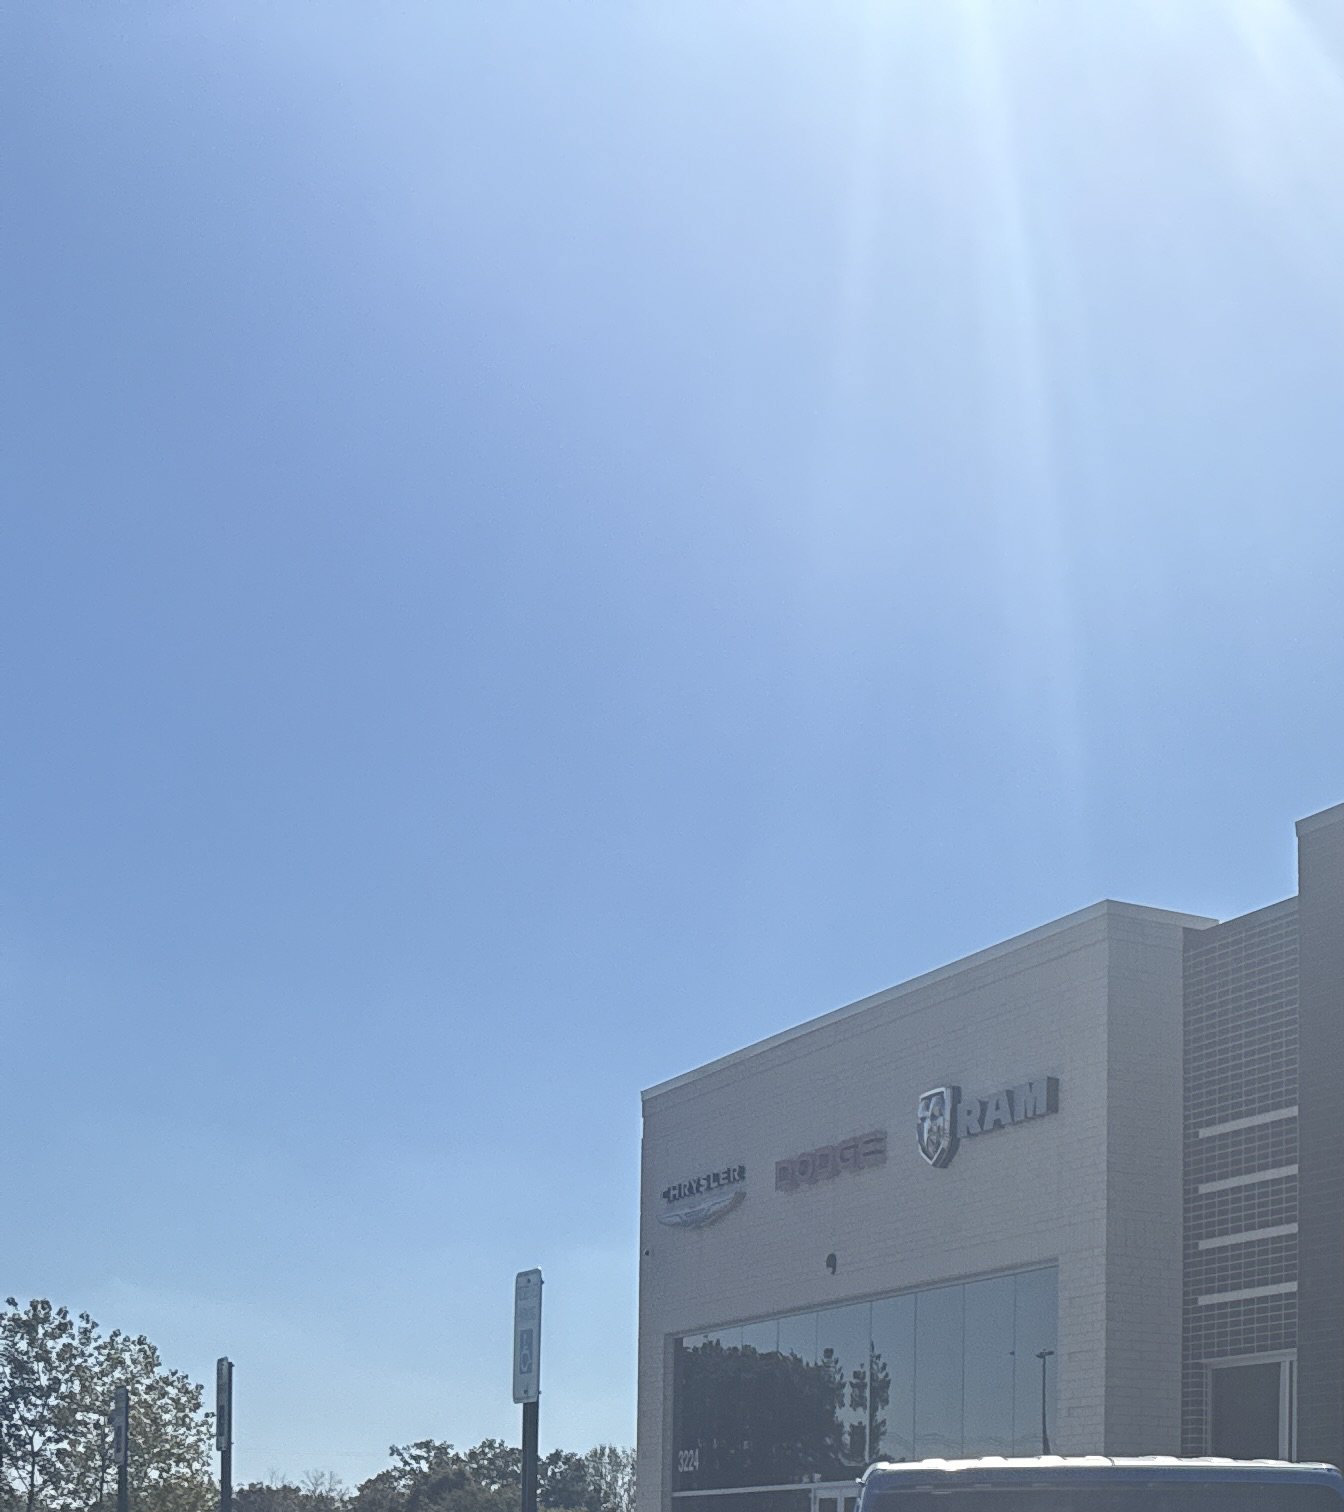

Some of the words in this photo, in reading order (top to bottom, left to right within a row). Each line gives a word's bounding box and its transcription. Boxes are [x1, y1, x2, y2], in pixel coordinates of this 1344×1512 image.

[956, 1077, 1059, 1139] RAM
[661, 1165, 747, 1204] CHRYSLER
[775, 1130, 888, 1195] DODGE
[678, 1448, 699, 1473] 3224
